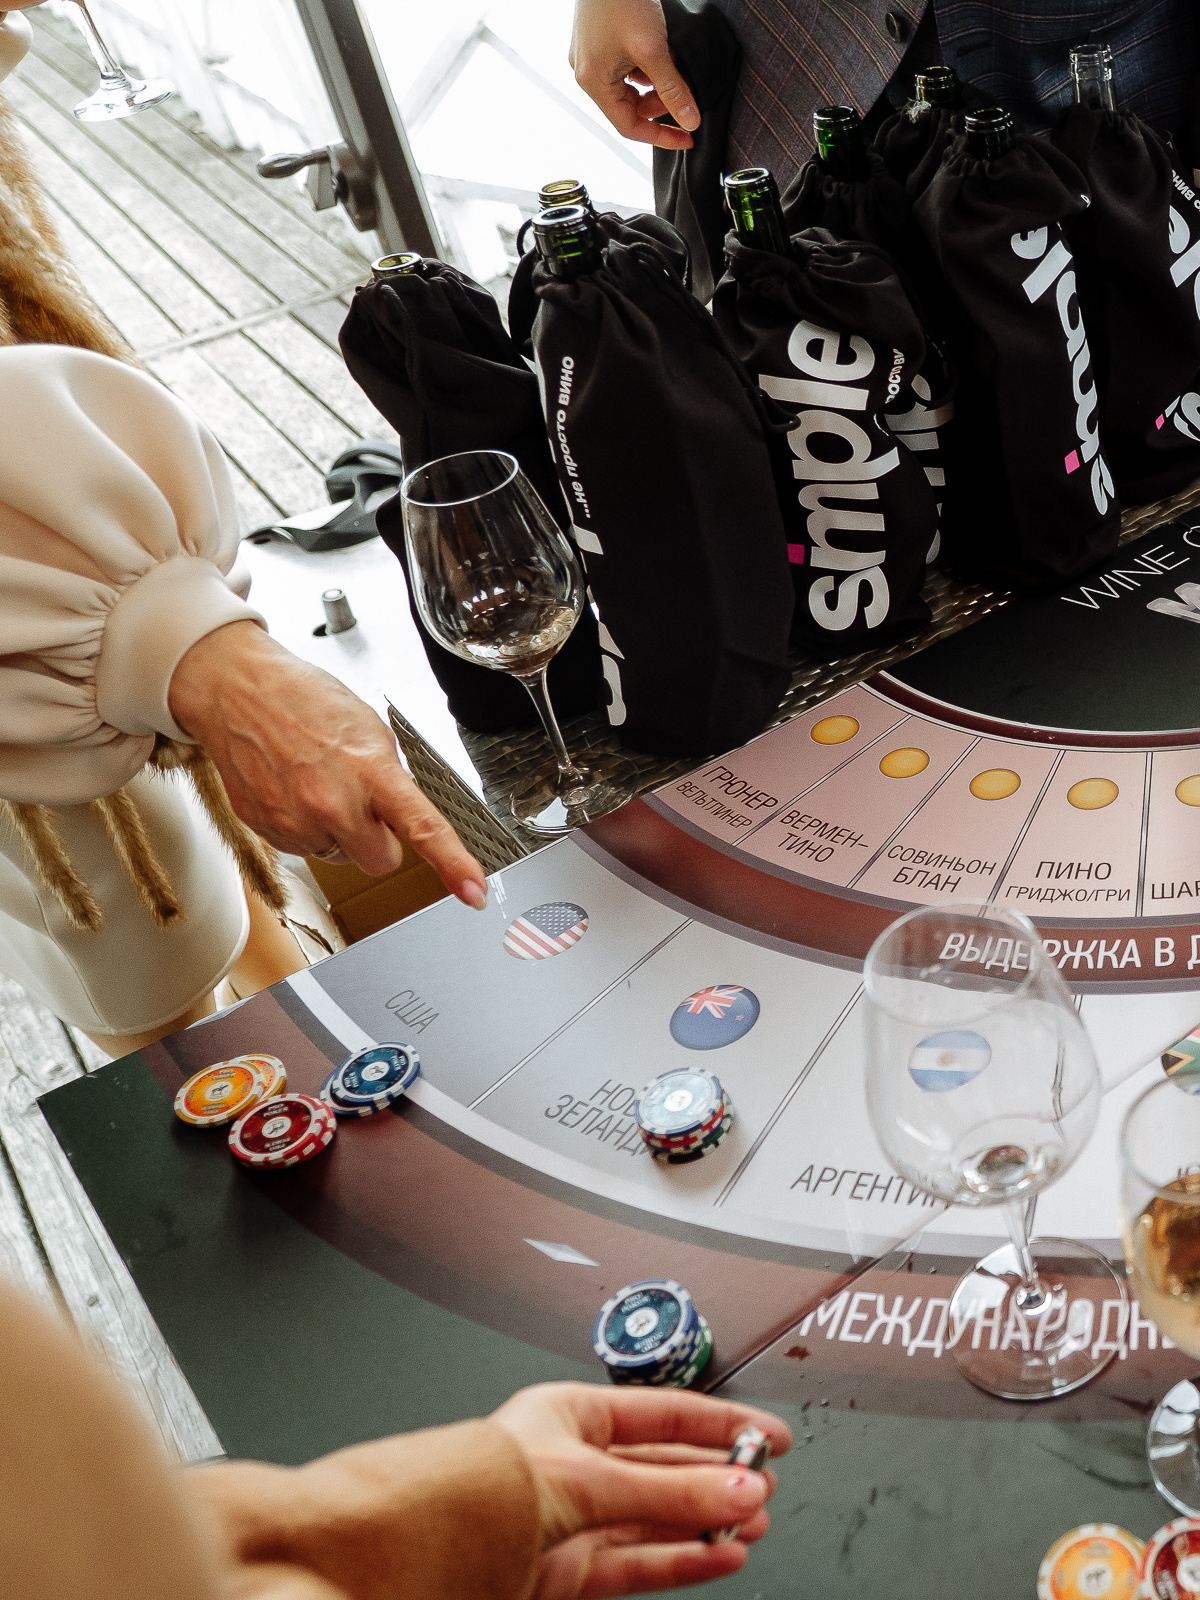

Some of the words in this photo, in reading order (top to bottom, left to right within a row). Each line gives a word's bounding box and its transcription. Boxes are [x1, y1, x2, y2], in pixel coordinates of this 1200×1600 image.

[557, 355, 575, 406] ВИНО
[556, 409, 579, 478] просто
[1061, 544, 1190, 610] WINE
[675, 780, 753, 830] ВЕЛЬТЛИНЕР
[701, 764, 778, 812] ГРЮНЕР
[778, 832, 835, 863] ТИНО
[779, 809, 869, 849] ВЕРМЕН-
[886, 844, 997, 876] СОВИНЬОН
[892, 866, 962, 894] БЛАН
[1035, 860, 1112, 881] ПИНО
[1004, 885, 1131, 903] ГРИДЖО/ГРИ
[938, 932, 1142, 973] ВЫДЕРЖКА
[1154, 937, 1176, 967] В
[383, 989, 441, 1035] США
